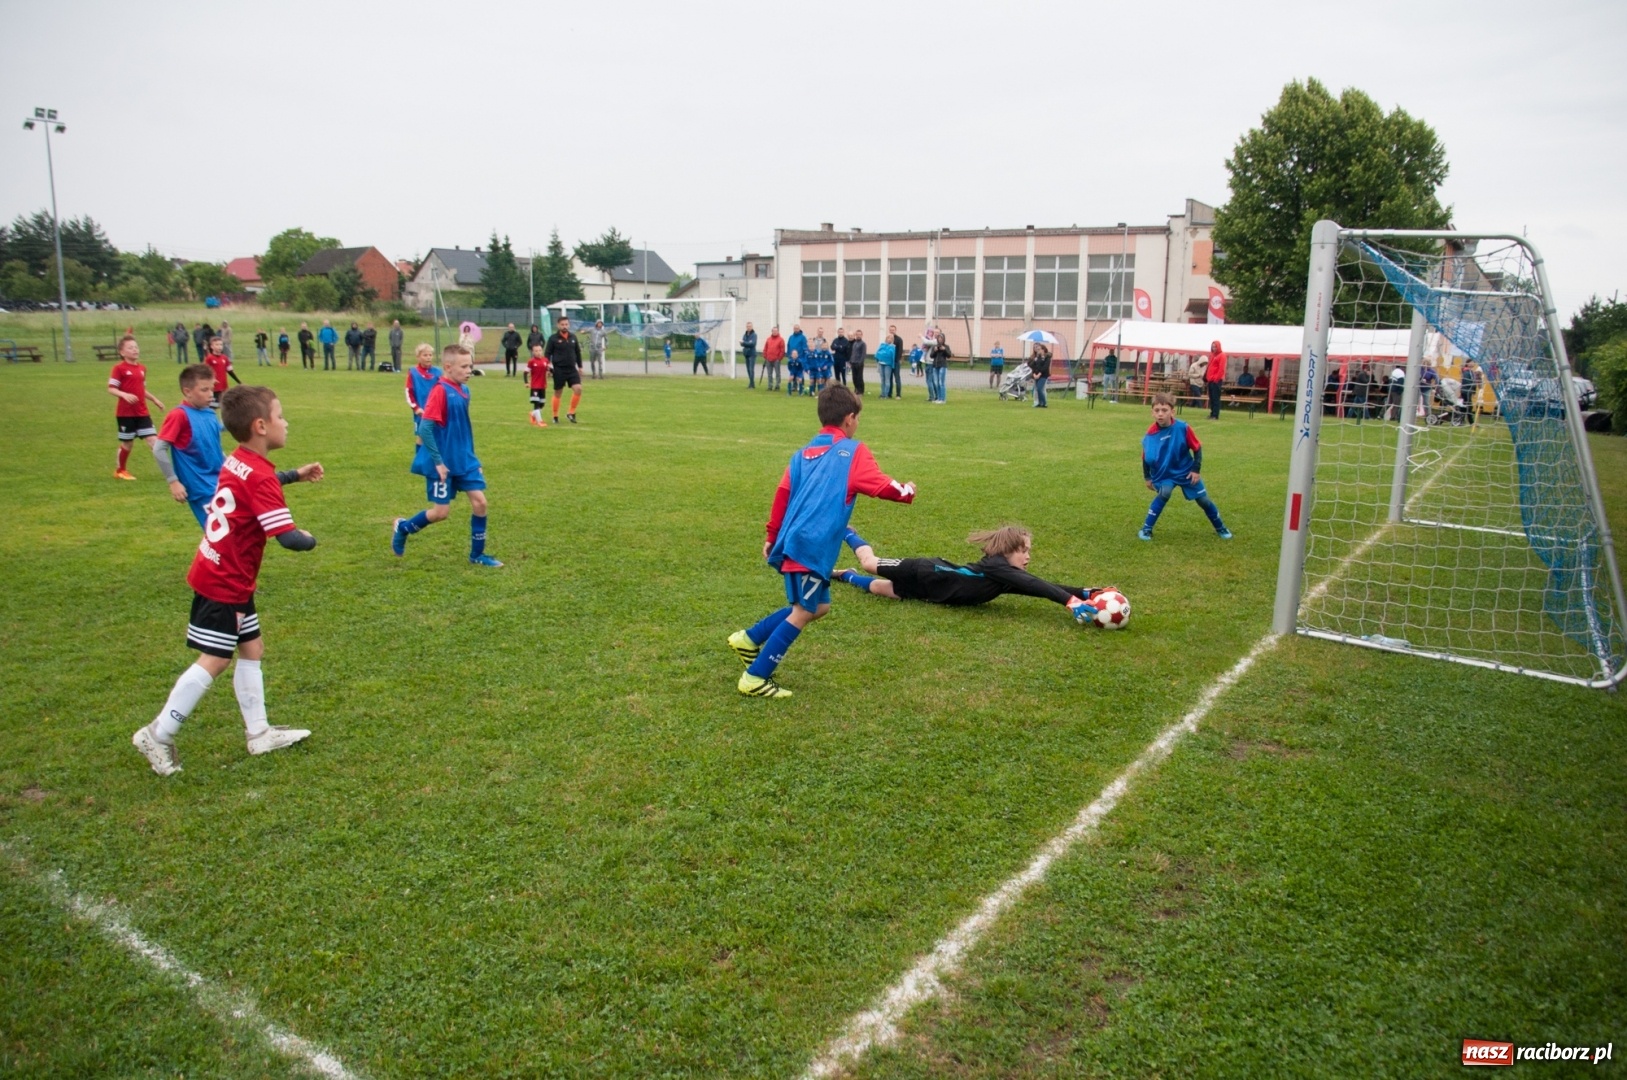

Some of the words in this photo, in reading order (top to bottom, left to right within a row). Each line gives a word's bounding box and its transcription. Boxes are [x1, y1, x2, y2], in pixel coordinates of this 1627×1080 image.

[1303, 349, 1318, 424] POLSPORT
[433, 481, 448, 499] 13
[801, 574, 822, 600] 17
